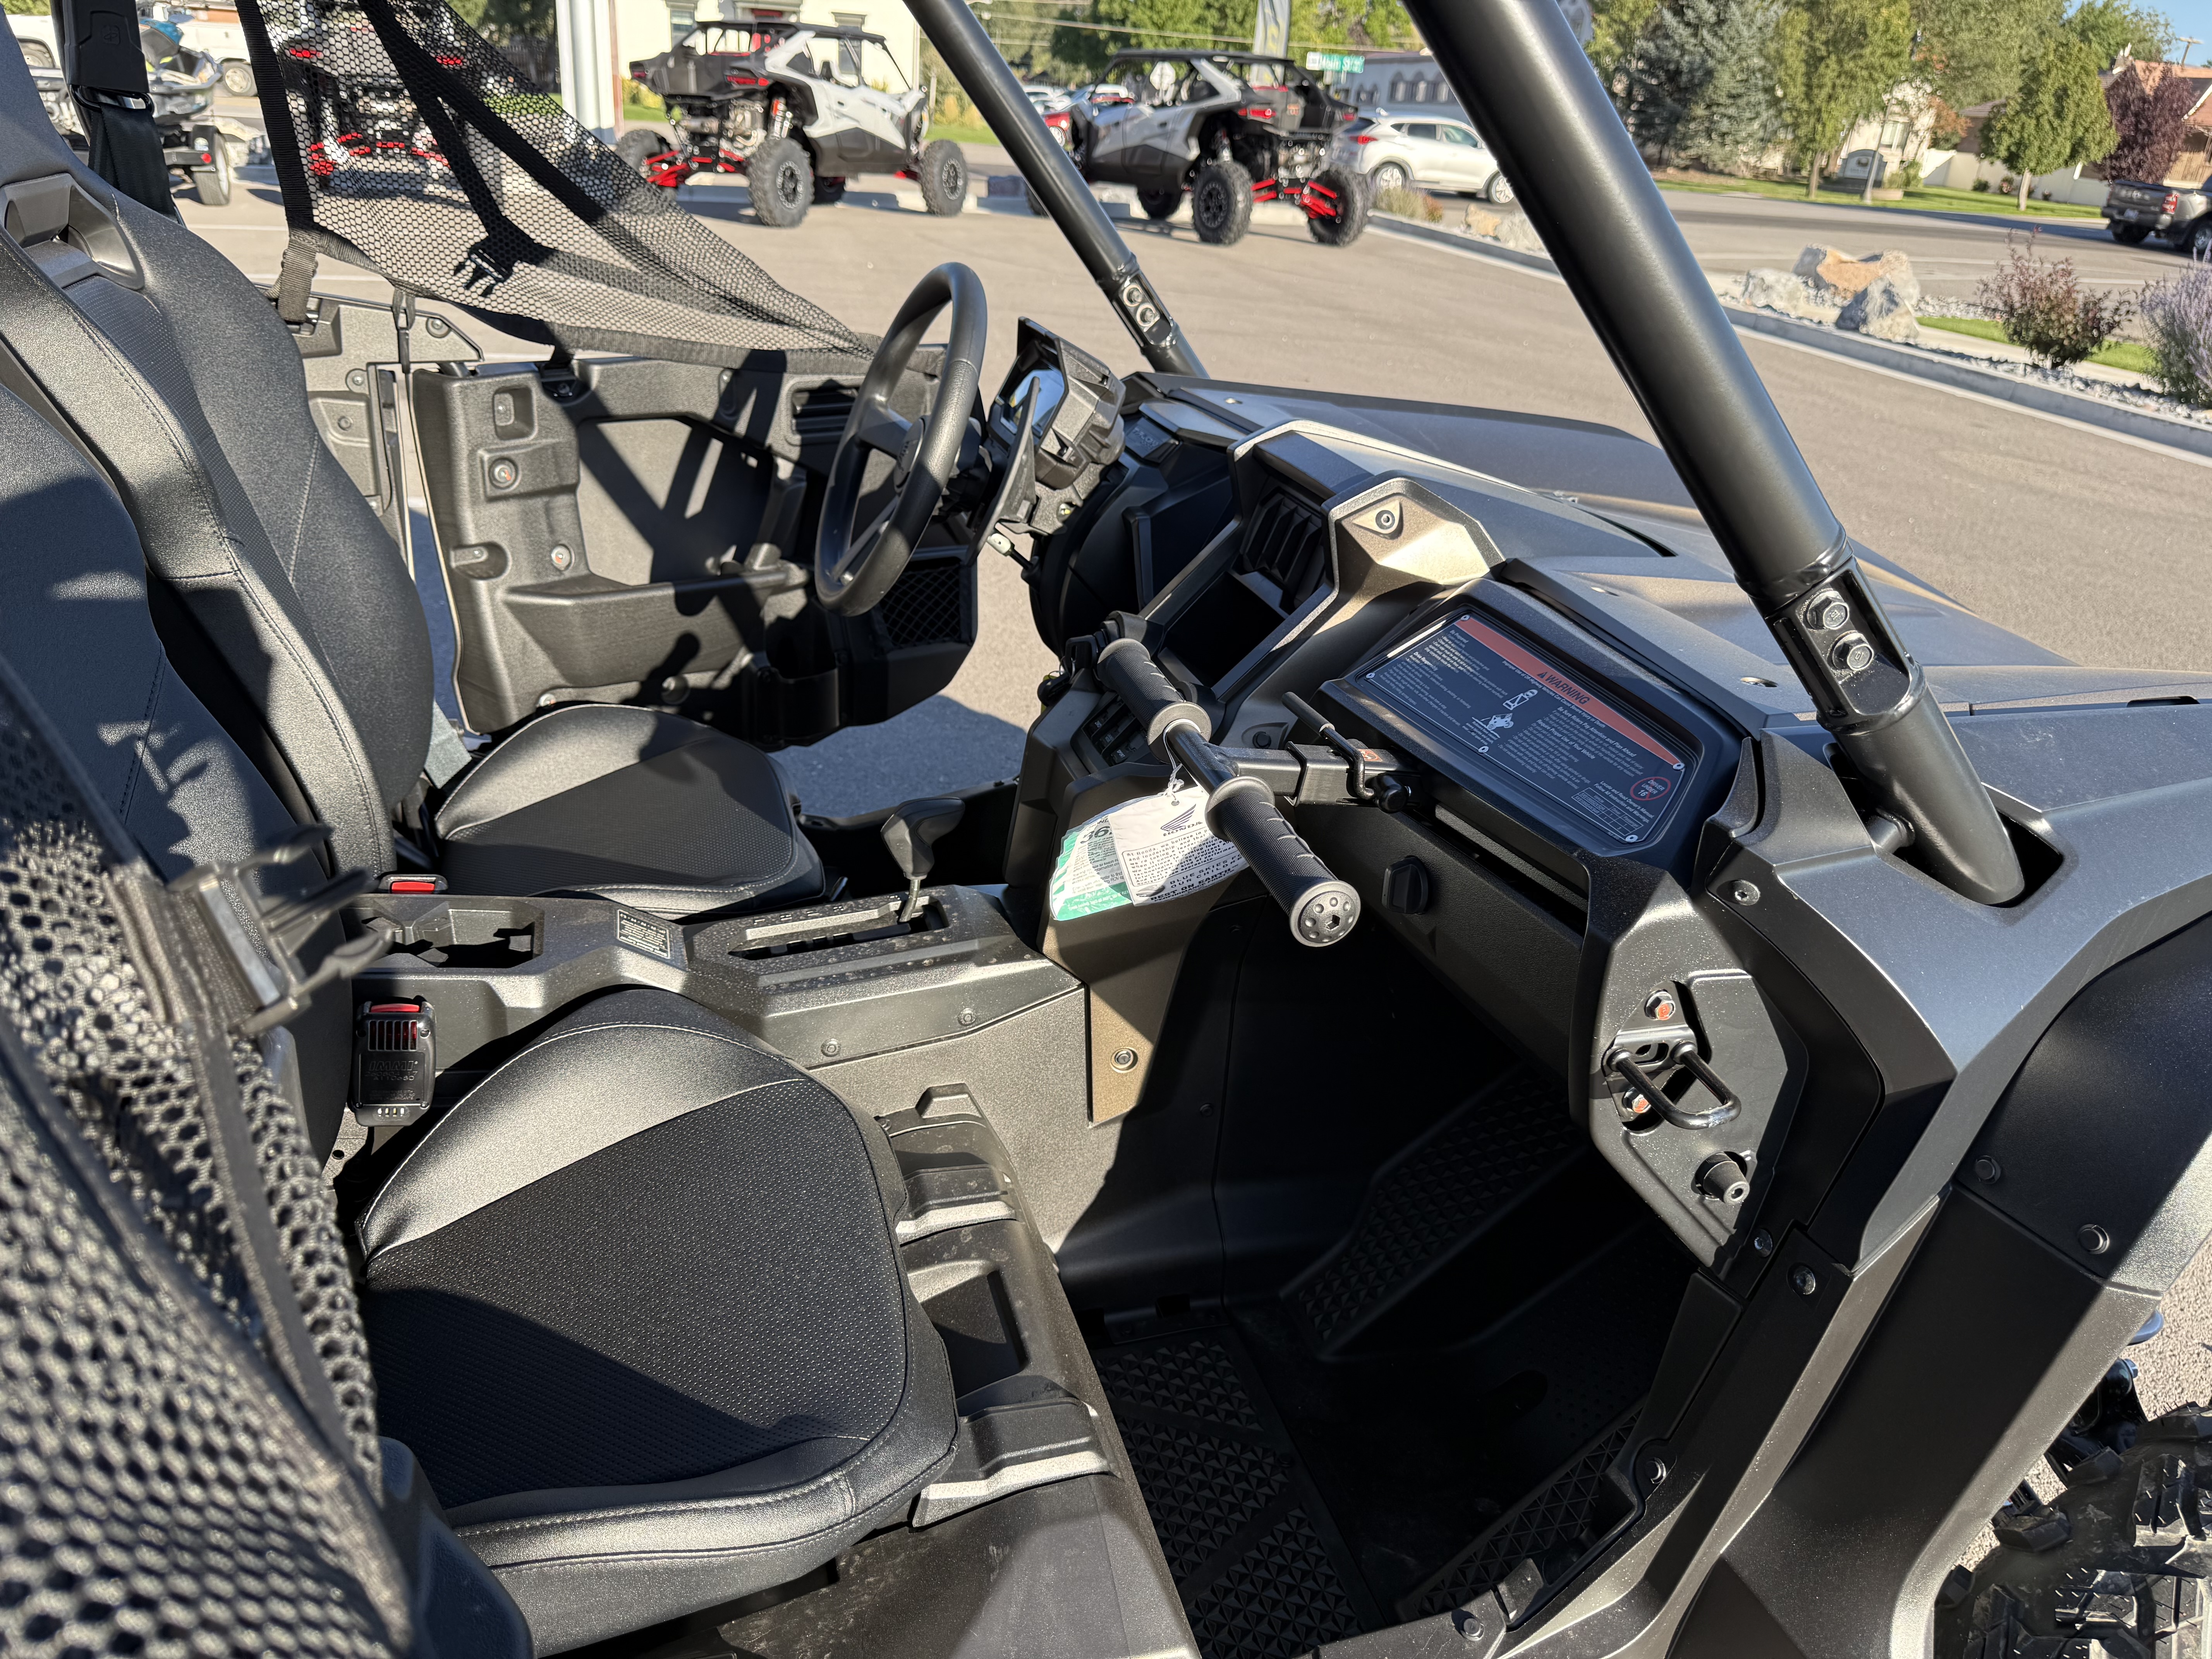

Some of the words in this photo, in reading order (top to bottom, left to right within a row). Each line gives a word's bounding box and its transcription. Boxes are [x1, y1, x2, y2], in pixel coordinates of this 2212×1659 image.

[1545, 675, 1590, 704] WARNING
[1536, 719, 1551, 729] Require
[1549, 728, 1563, 737] Proper
[1581, 749, 1595, 759] Vehicle
[1570, 715, 1583, 724] Riders
[1589, 727, 1607, 739] Attention
[1621, 748, 1637, 757] Ahead
[1600, 781, 1613, 789] Locate
[1641, 783, 1657, 794] UNDER
[1648, 780, 1664, 791] DRIVER
[1594, 783, 1605, 792] Follow
[1609, 793, 1627, 807] Instruction
[1163, 821, 1203, 836] HONDA
[1170, 872, 1195, 884] BLUE
[1199, 859, 1228, 874] SKIES
[1171, 878, 1192, 888] OUR
[1151, 890, 1177, 900] BEST
[369, 1060, 414, 1071] IMMI
